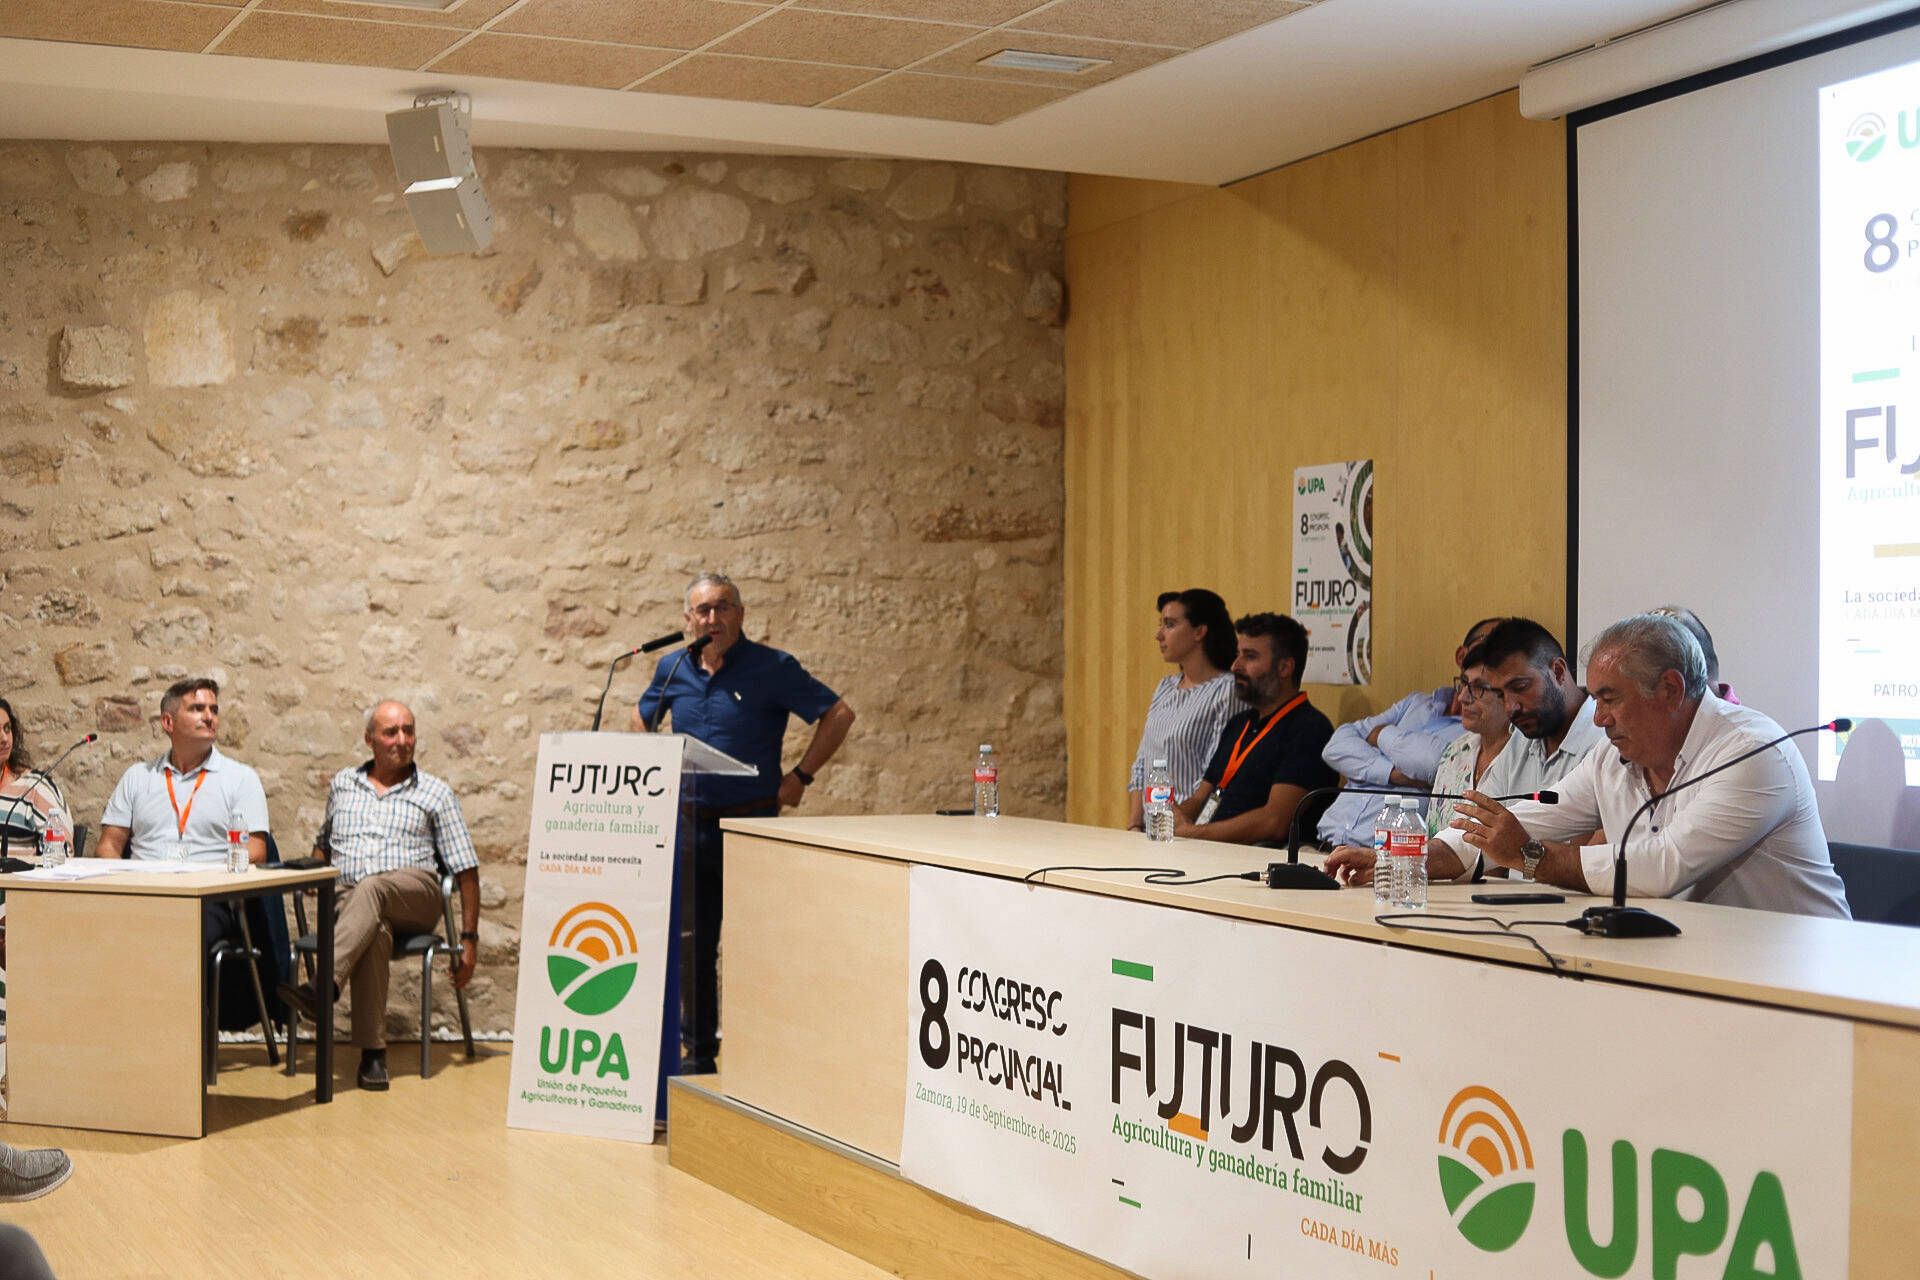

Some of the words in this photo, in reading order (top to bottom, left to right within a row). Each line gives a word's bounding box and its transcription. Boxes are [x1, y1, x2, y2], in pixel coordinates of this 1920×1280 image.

[1864, 213, 1899, 273] 8
[1307, 477, 1326, 494] UPA
[1300, 513, 1309, 535] 8
[1296, 579, 1357, 607] FUTURO
[1844, 590, 1862, 603] La
[550, 763, 665, 797] FUTURO
[563, 800, 633, 816] Agricultura
[637, 805, 645, 818] y
[609, 819, 660, 834] familiar
[540, 851, 550, 860] La
[553, 852, 588, 863] sociedad
[590, 855, 605, 863] nos
[608, 856, 642, 865] necesita
[919, 959, 951, 1070] 8
[957, 967, 1068, 1037] CONGRESO
[539, 1025, 630, 1081] UPA
[566, 1082, 578, 1092] de
[957, 1032, 1072, 1112] PROVINCIAL
[521, 1090, 578, 1104] Agricultores
[588, 1098, 643, 1113] Ganaderos
[1112, 1007, 1372, 1175] FUTURO
[916, 1082, 954, 1113] Zamora,
[957, 1095, 968, 1113] 19
[969, 1101, 981, 1118] de
[983, 1104, 1037, 1140] Septiembre
[1039, 1123, 1051, 1145] de
[1052, 1129, 1077, 1154] 2025
[1111, 1113, 1192, 1159] Agricultura
[1196, 1143, 1205, 1168] y
[1208, 1148, 1288, 1190] ganadería
[1292, 1168, 1363, 1213] familiar
[1562, 1128, 1804, 1280] UPA
[1301, 1217, 1338, 1245] CADA
[1341, 1227, 1365, 1253] DÍA
[1368, 1239, 1399, 1267] MÁS
